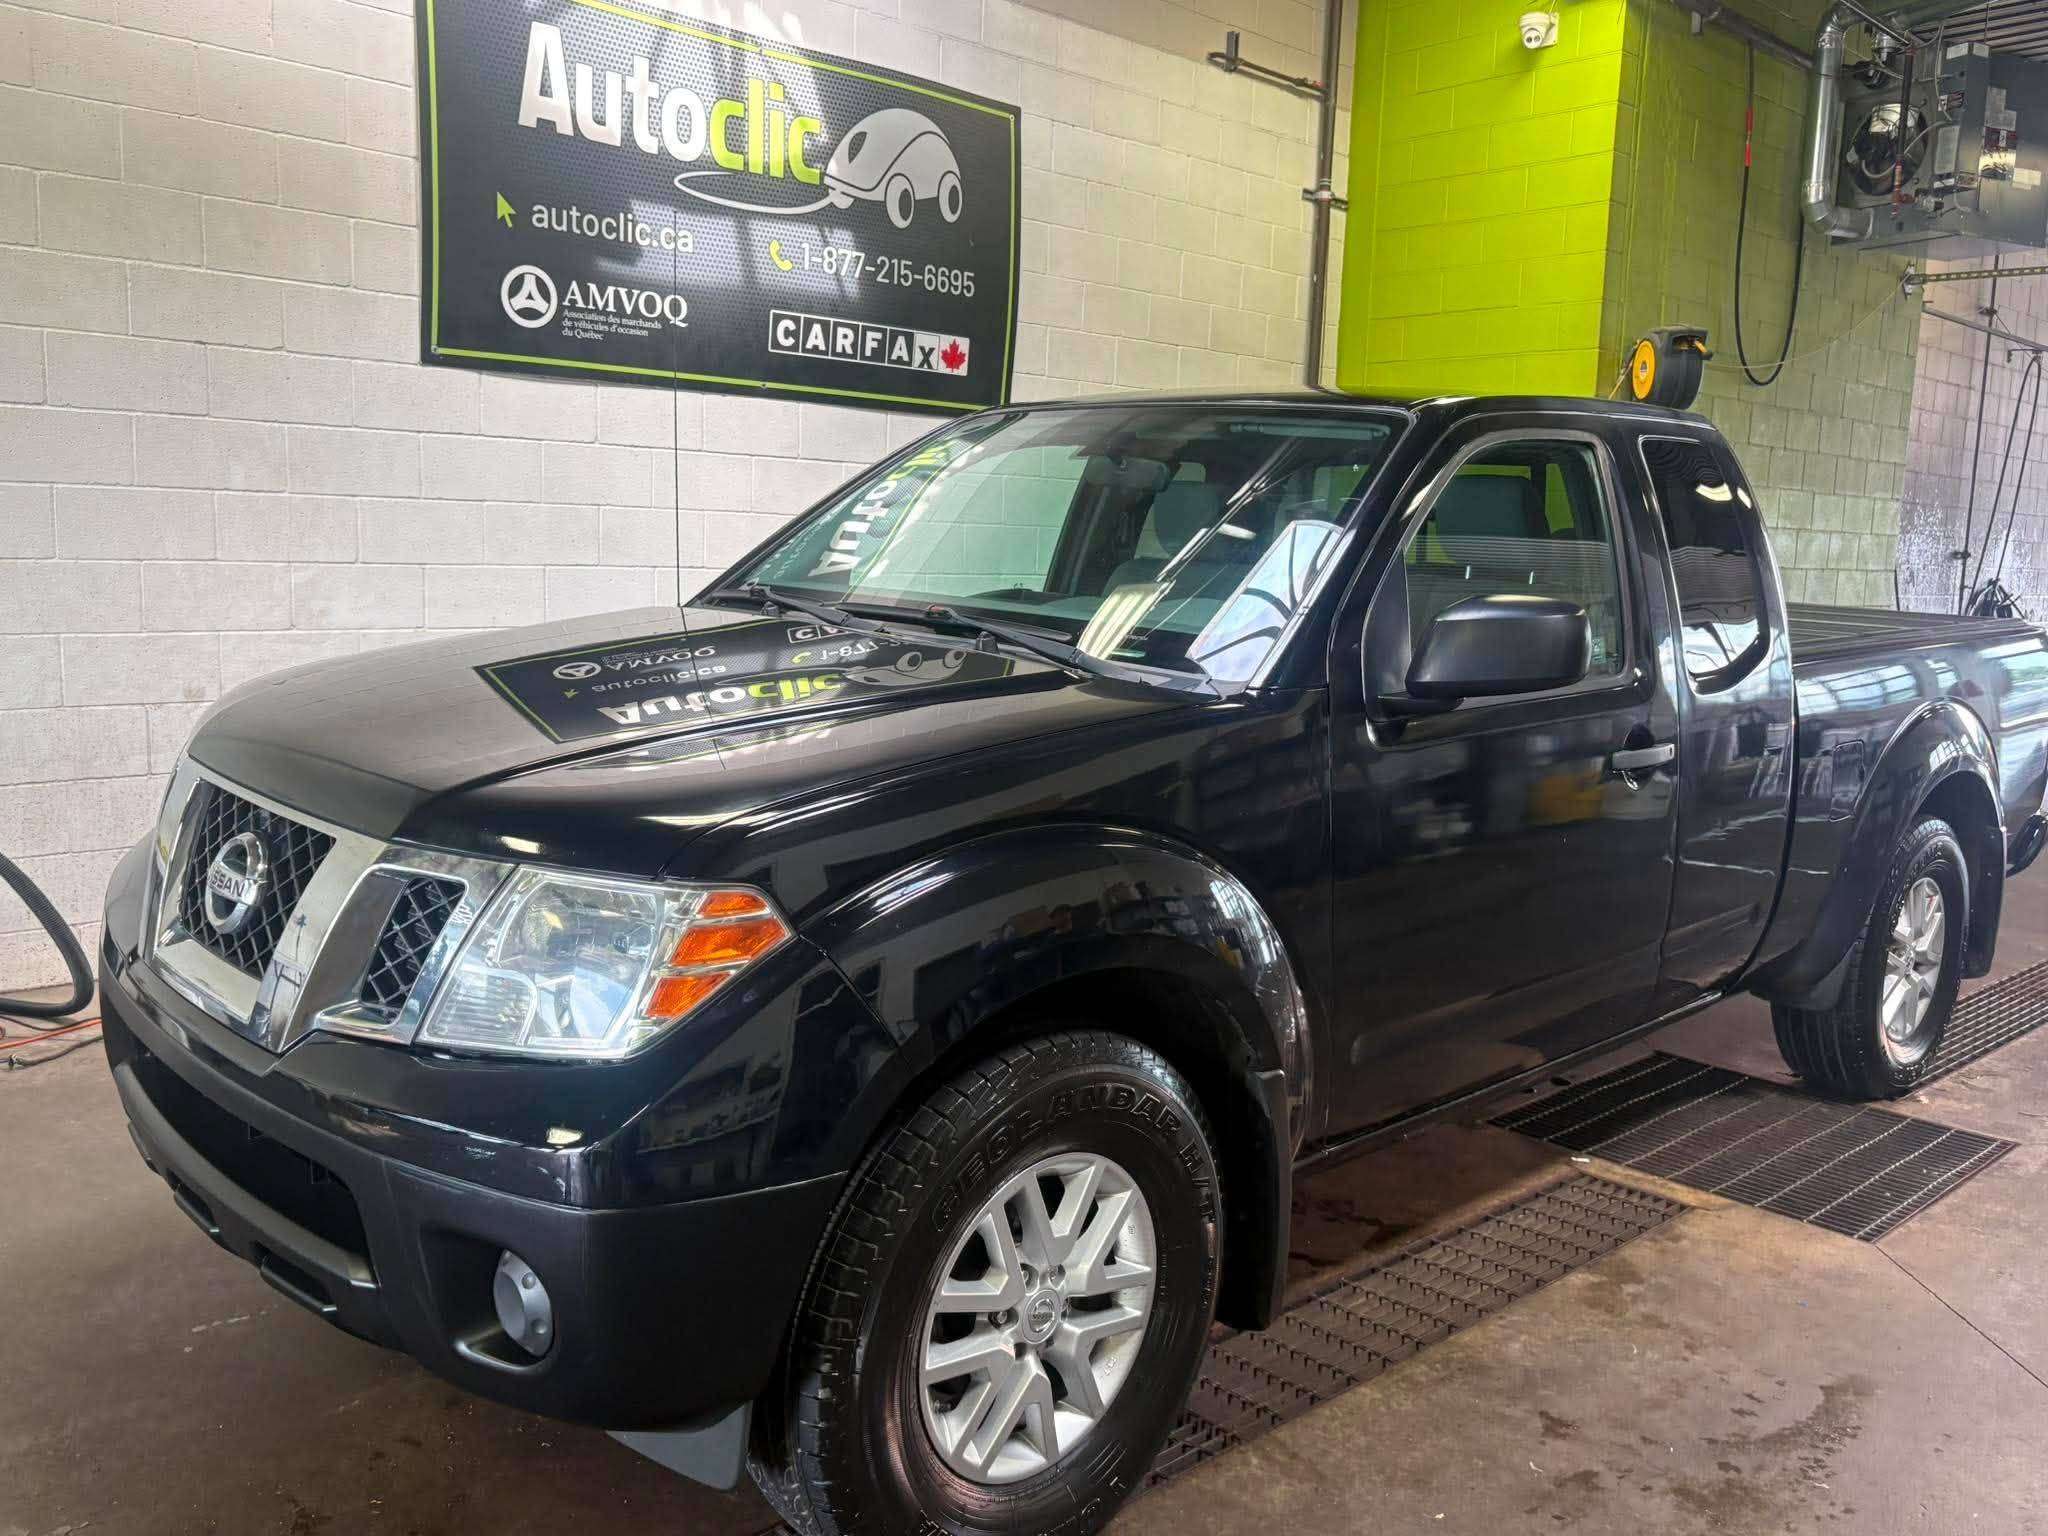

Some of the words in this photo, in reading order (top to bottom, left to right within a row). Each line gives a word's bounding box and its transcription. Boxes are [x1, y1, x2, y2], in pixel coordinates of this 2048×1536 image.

[518, 20, 821, 185] Autoclic
[531, 203, 694, 253] autoclic.ca
[801, 242, 975, 297] 1-877-215-6695
[562, 279, 689, 328] AMVOQ
[562, 318, 573, 327] de
[563, 309, 607, 322] Association
[608, 314, 621, 324] des
[621, 318, 663, 330] marchands
[562, 327, 574, 337] du
[775, 318, 938, 370] CARFAX
